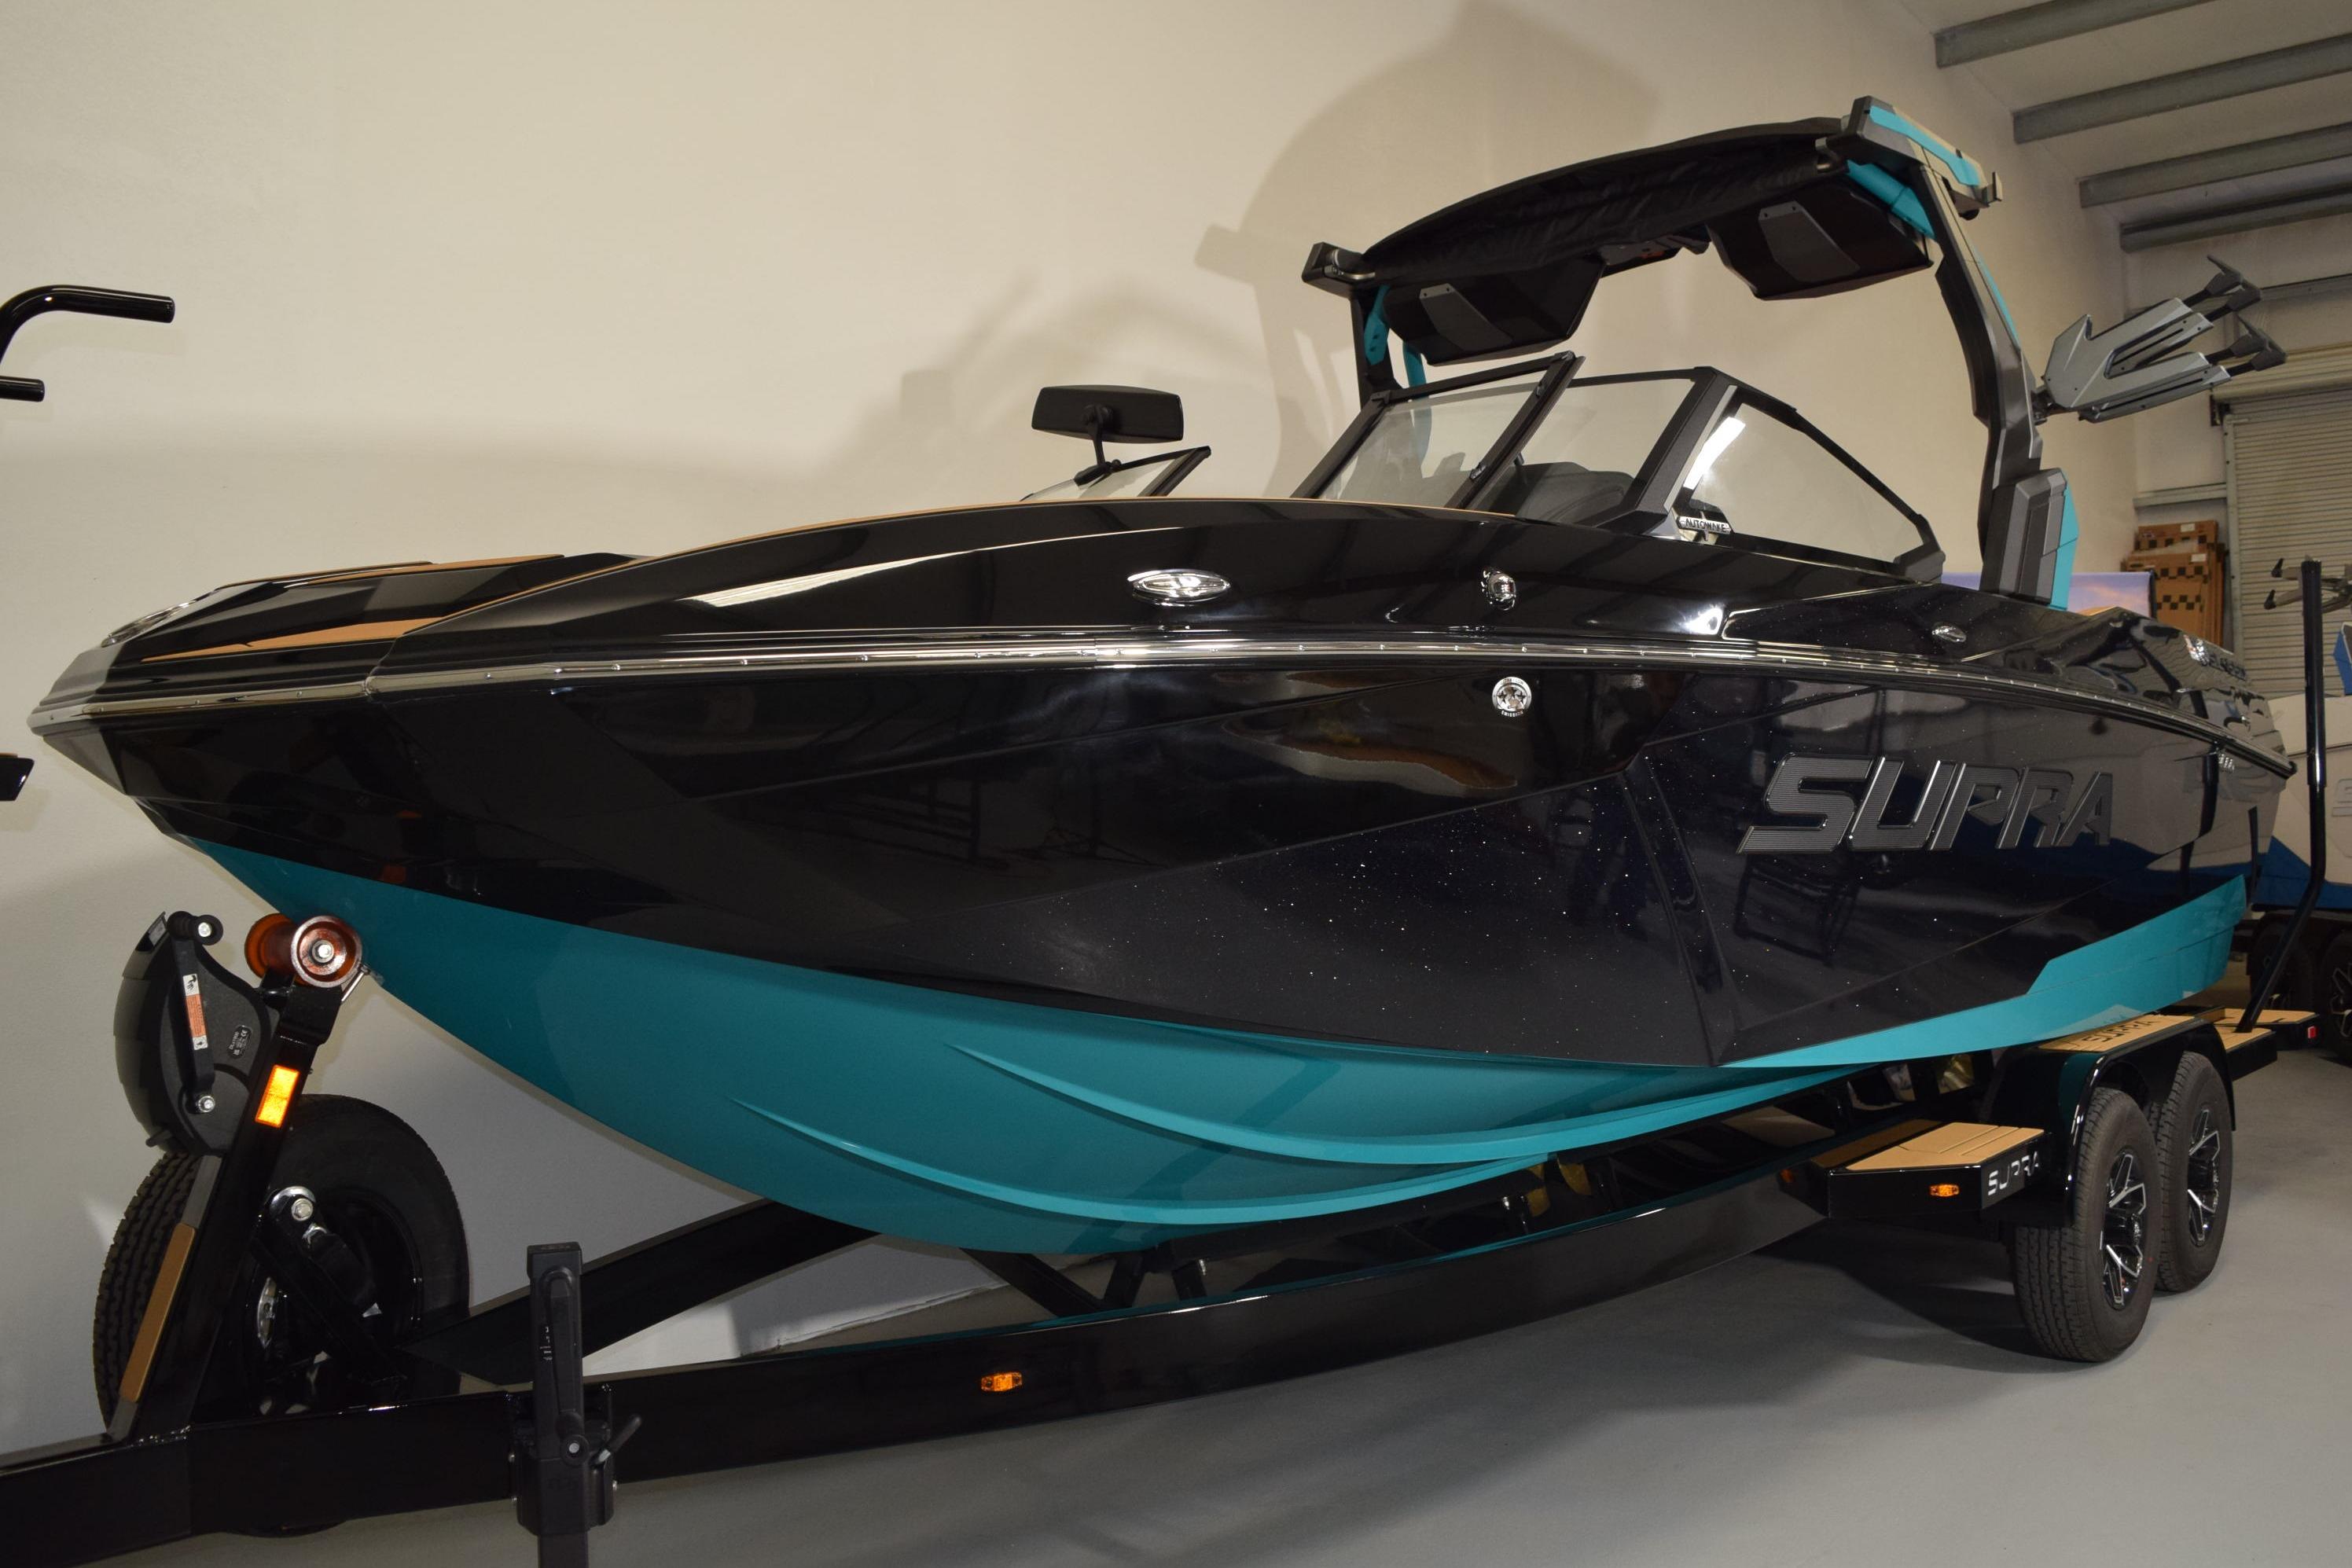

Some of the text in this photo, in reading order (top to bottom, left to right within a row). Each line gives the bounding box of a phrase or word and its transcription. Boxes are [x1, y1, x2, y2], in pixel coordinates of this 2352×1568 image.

[1685, 518, 1725, 532] AUTOWAKE
[1736, 752, 2113, 854] SUPRA
[1987, 1151, 2039, 1195] SUPRA
